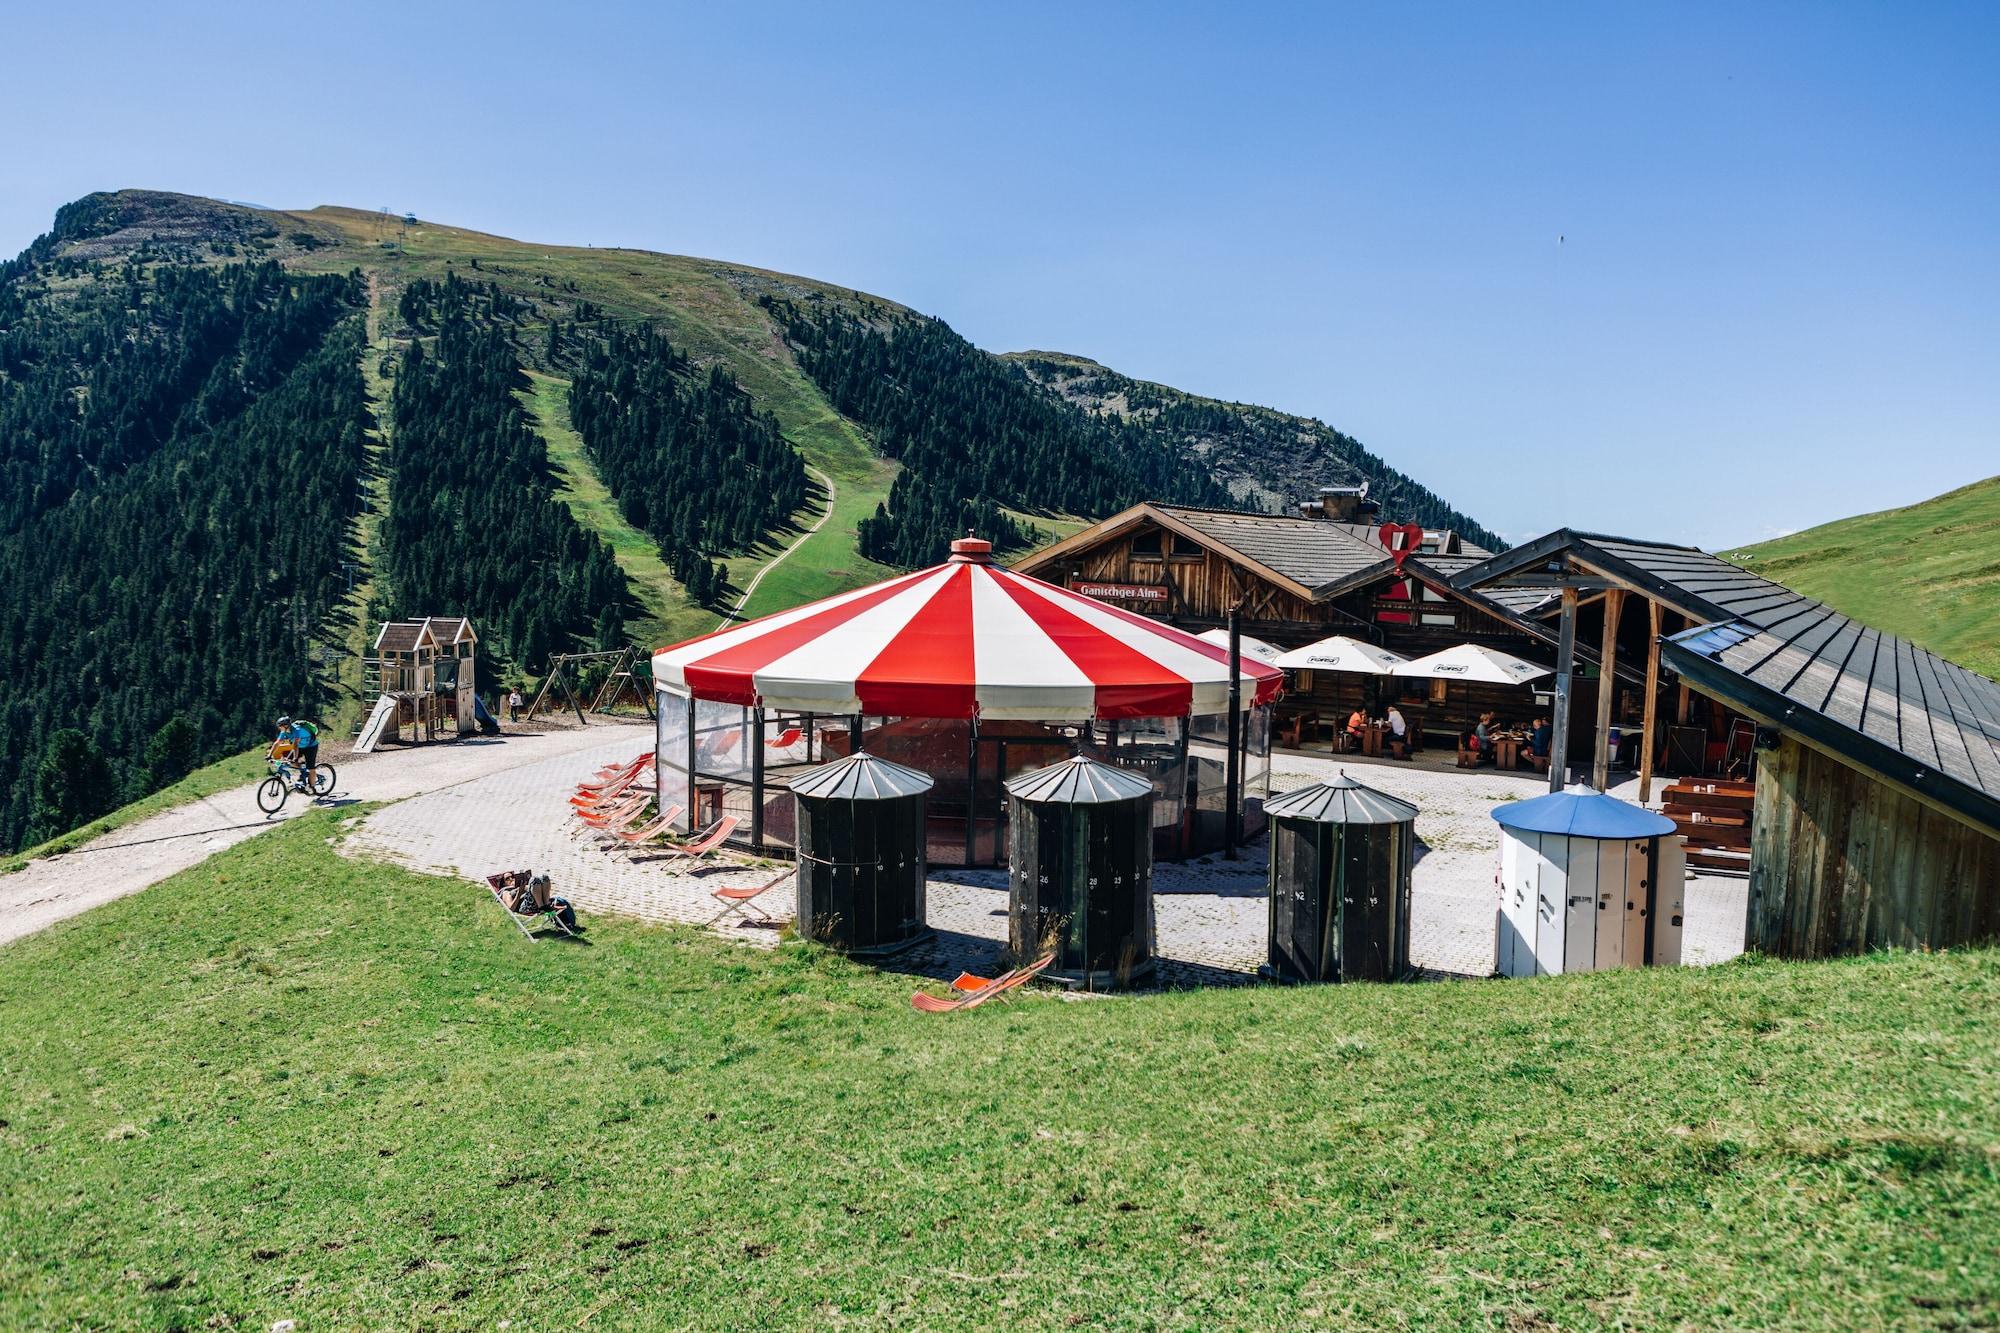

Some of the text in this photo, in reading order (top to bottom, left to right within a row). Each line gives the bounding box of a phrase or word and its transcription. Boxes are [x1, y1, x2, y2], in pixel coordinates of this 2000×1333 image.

[1081, 585, 1158, 599] Ganischger Alm
[1040, 875, 1049, 884] 26
